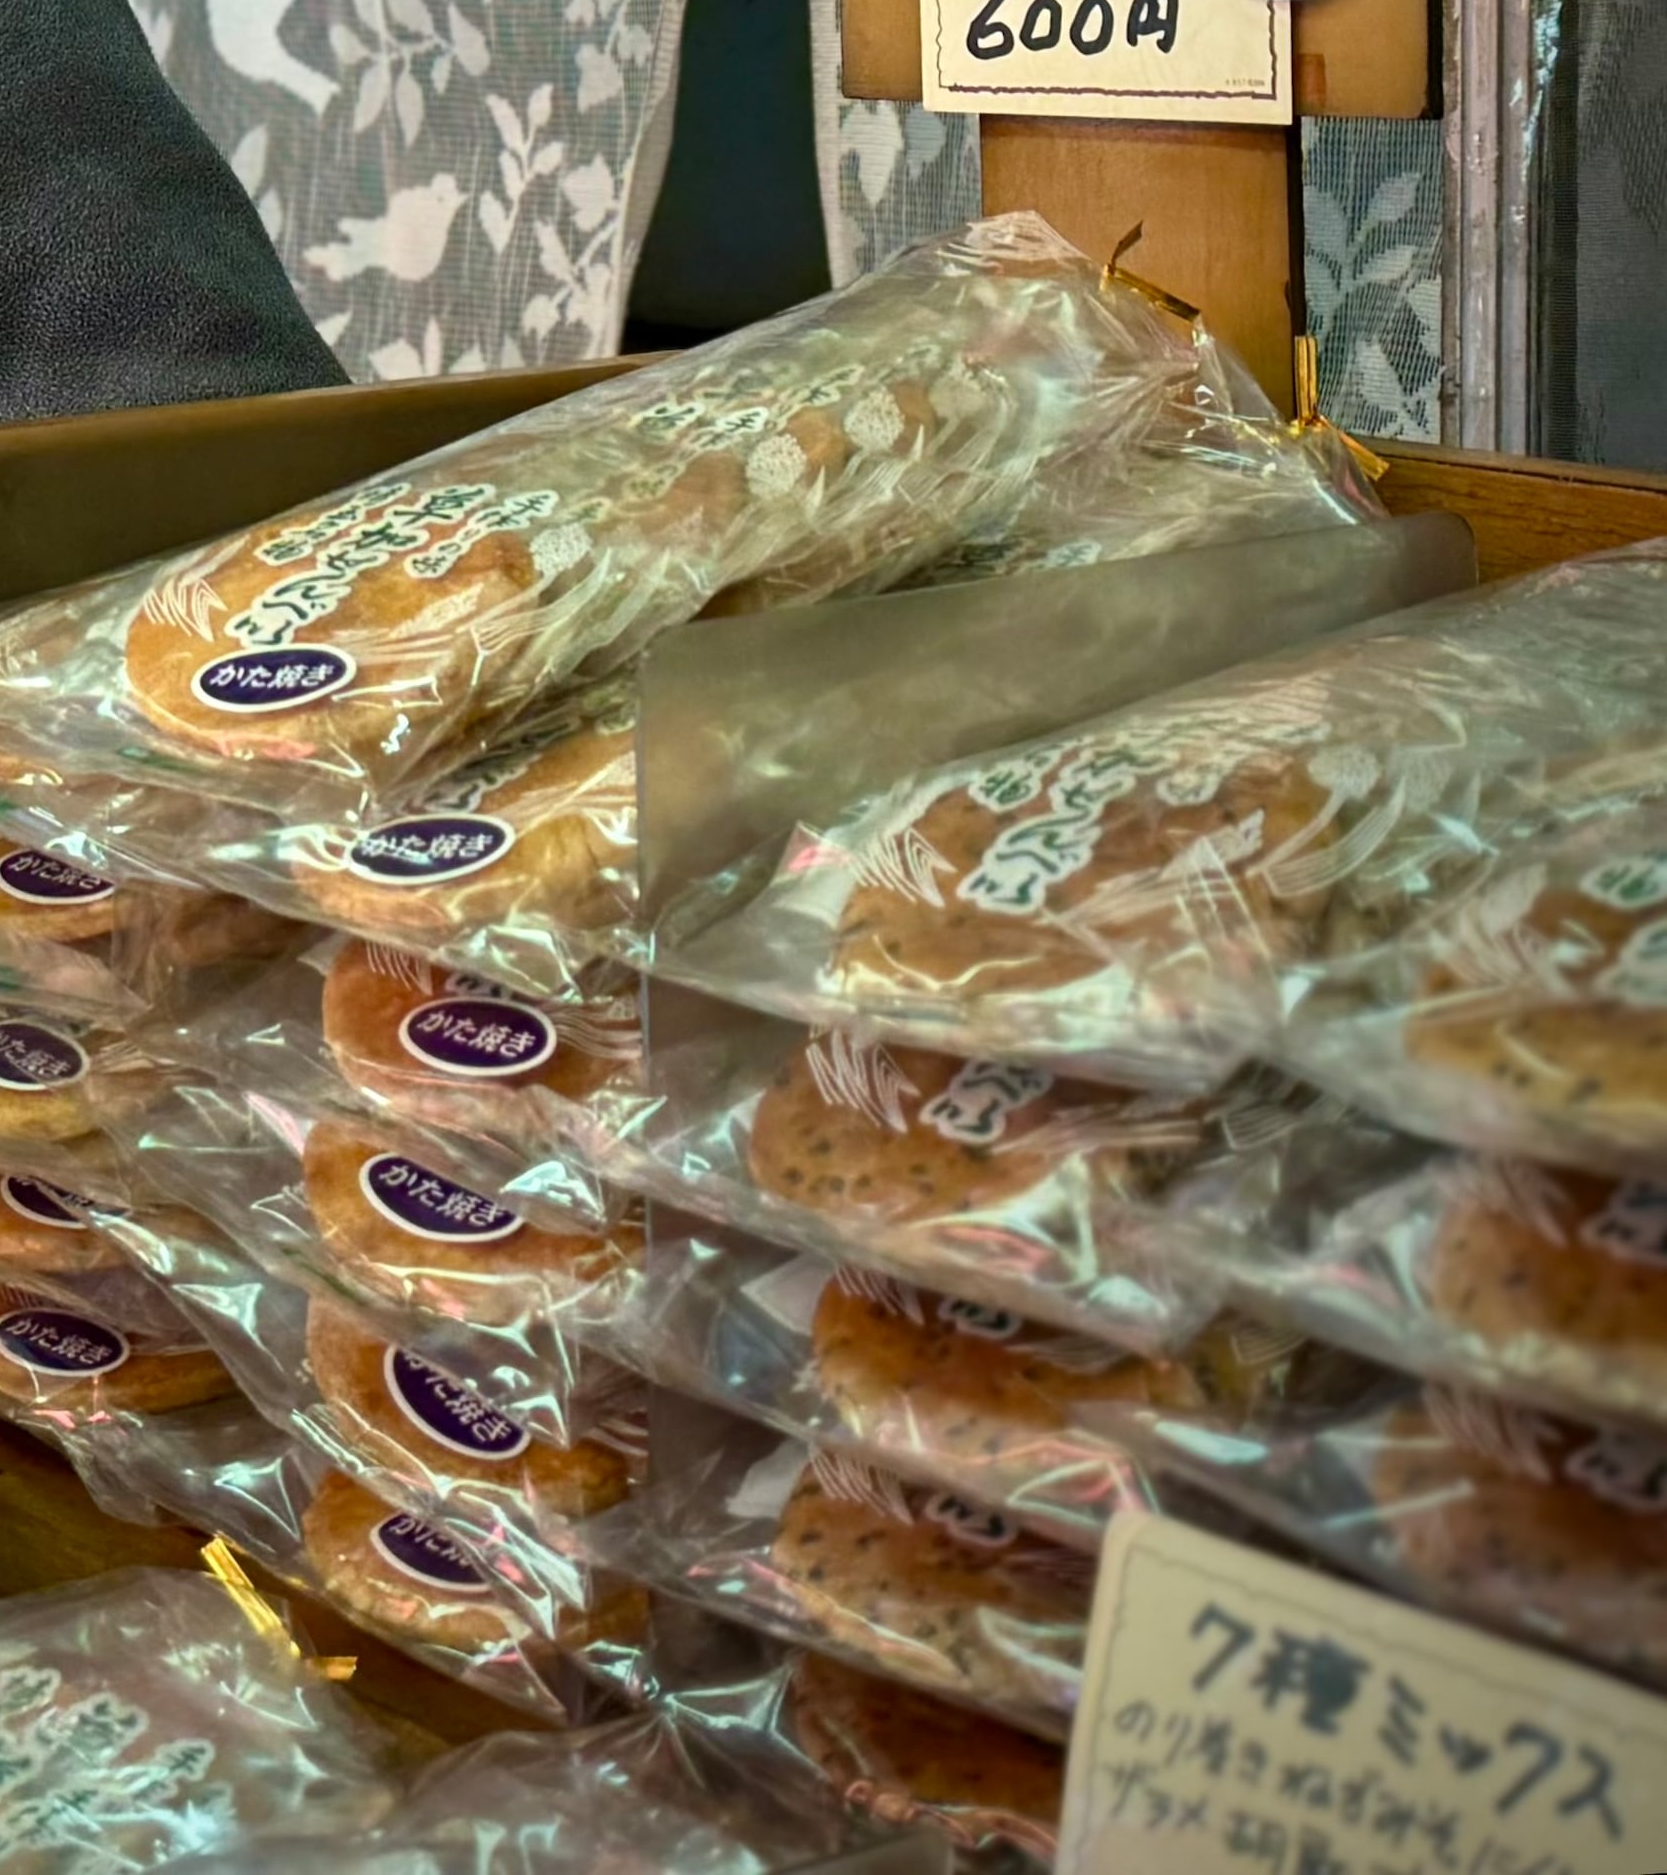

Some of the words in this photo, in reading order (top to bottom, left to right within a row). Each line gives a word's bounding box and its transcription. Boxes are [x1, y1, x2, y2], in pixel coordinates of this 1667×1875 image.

[236, 487, 485, 645] 草加せんべい
[209, 665, 335, 690] かた焼き
[418, 1010, 536, 1058] かた焼き
[380, 1164, 507, 1226] かた焼き
[7, 1317, 113, 1365] かた焼き
